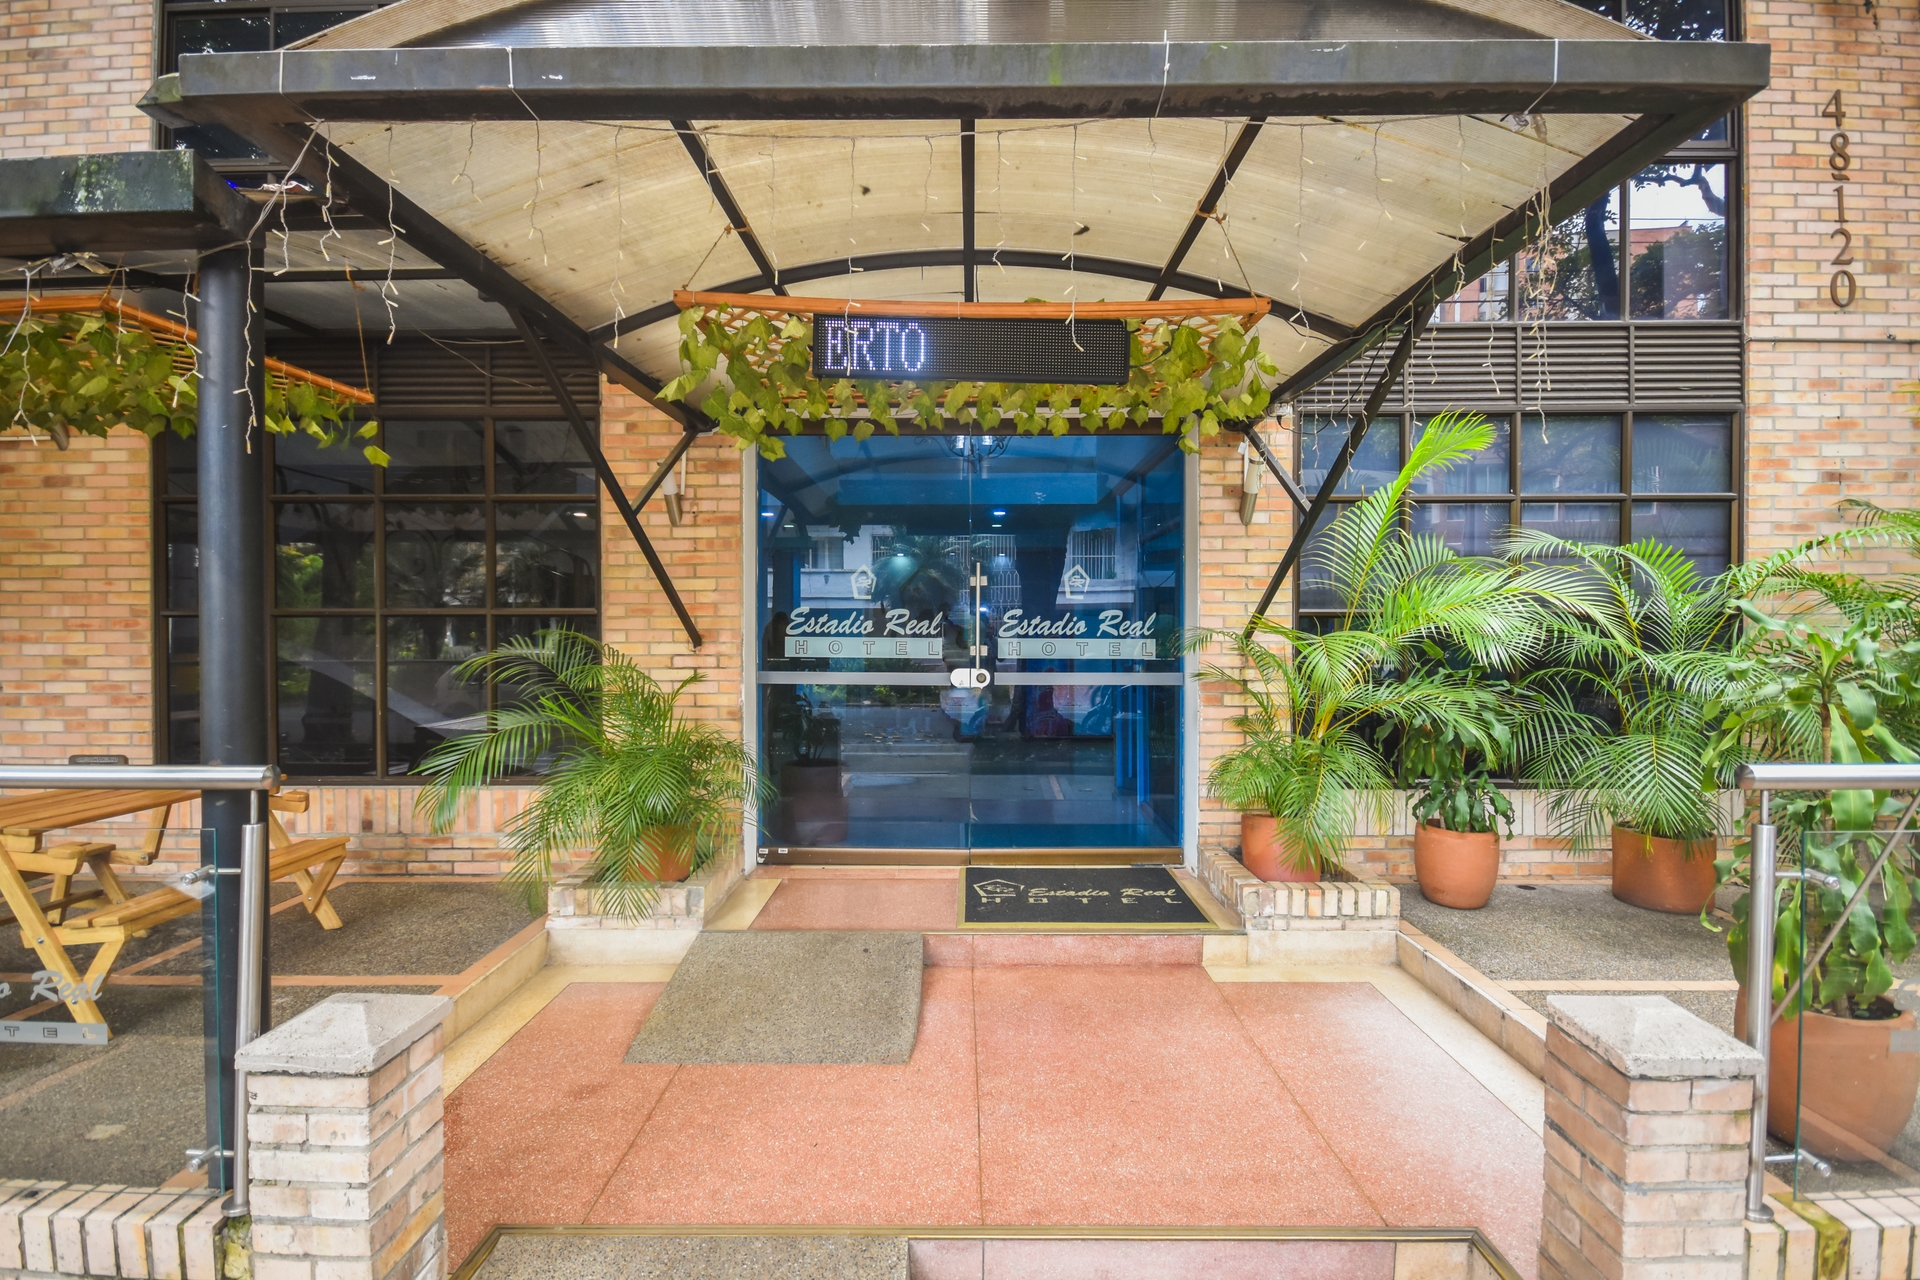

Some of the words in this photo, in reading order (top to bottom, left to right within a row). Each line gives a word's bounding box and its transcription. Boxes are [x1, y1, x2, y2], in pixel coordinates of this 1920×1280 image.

[1821, 88, 1857, 308] 48-120
[824, 320, 926, 371] ERTO
[785, 606, 875, 636] Estadio
[883, 608, 943, 636] Real
[998, 608, 1088, 638] Estadio
[1096, 609, 1156, 637] Real
[794, 640, 940, 656] HOTEL
[1007, 641, 1154, 657] HOTEL
[1027, 887, 1111, 897] Estadio
[1120, 888, 1177, 897] Real
[30, 969, 105, 1003] Real
